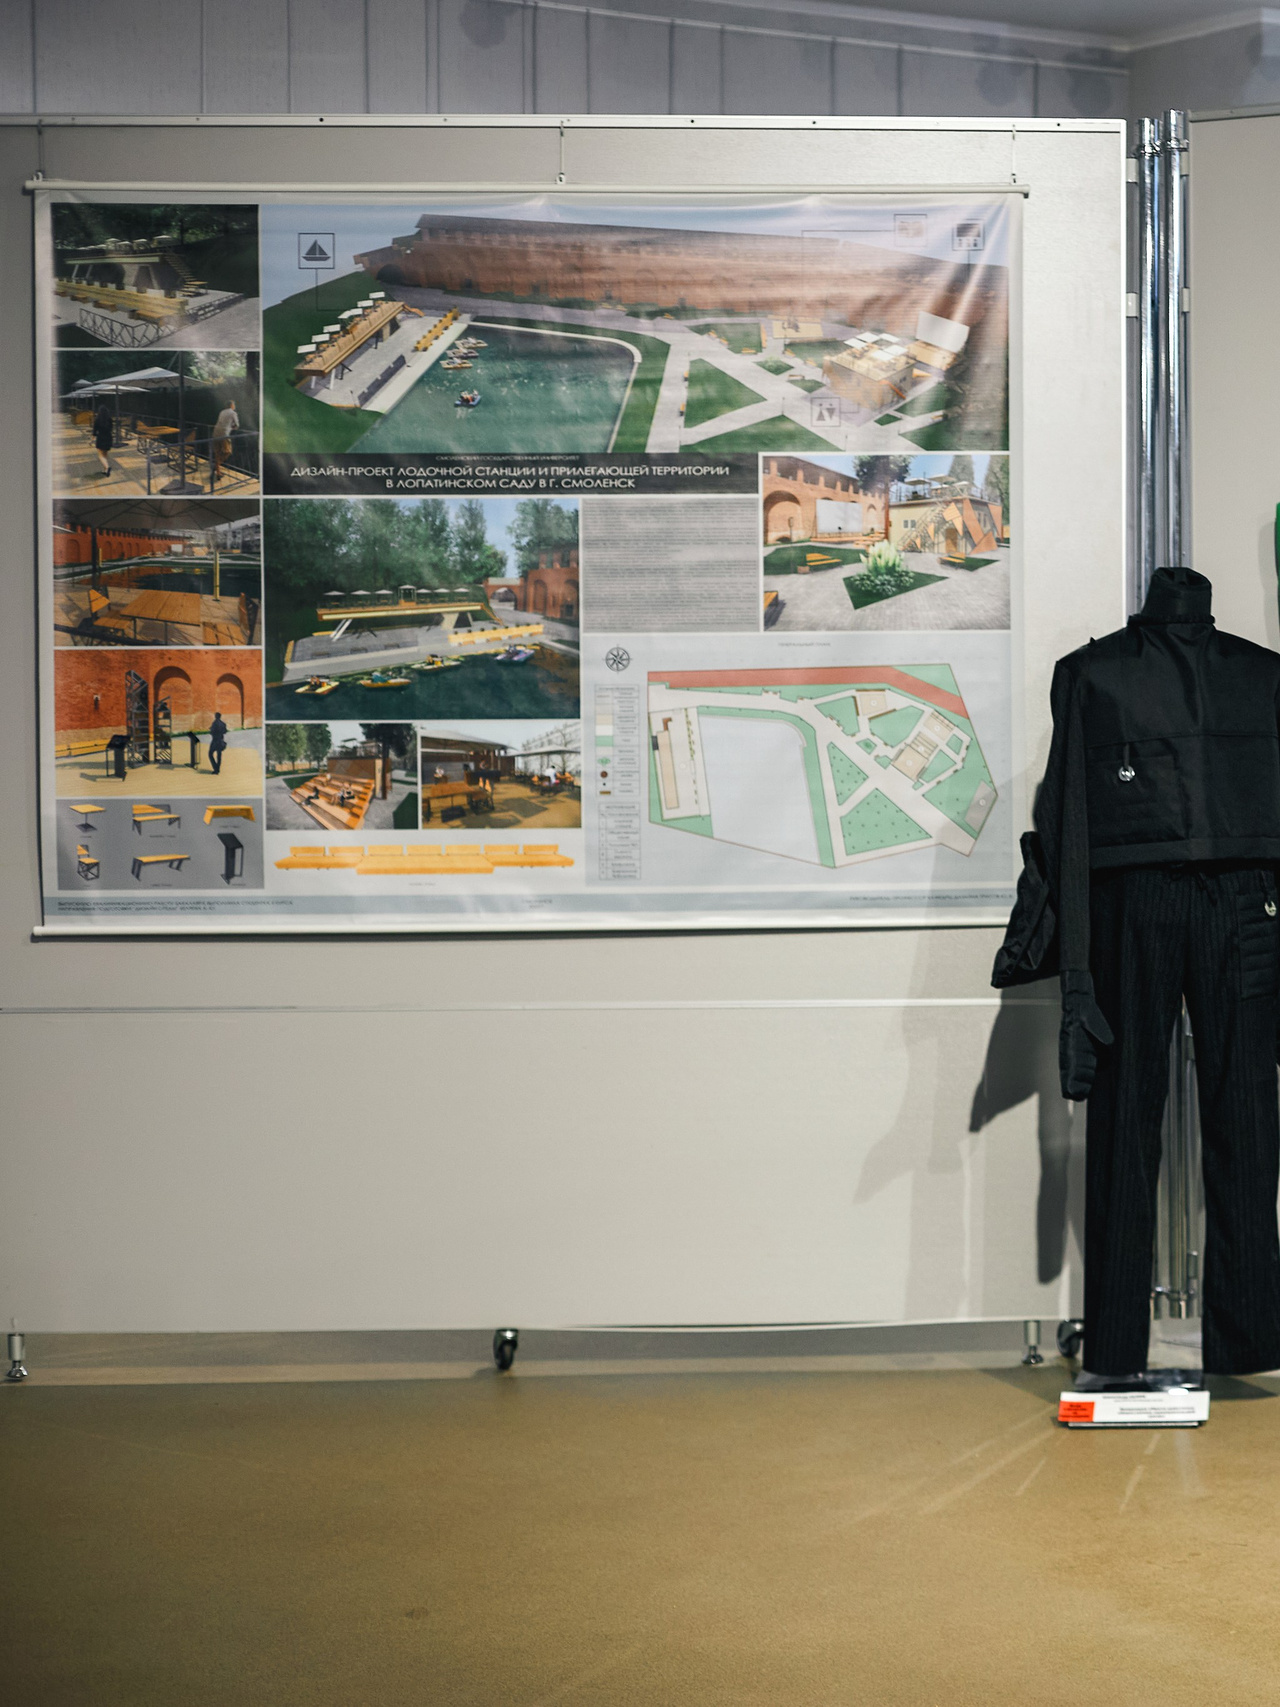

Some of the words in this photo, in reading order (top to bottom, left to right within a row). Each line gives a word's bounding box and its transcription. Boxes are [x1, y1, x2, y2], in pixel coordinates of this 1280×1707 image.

[290, 465, 394, 477] ДИЗАЙН-ПРОЕКТ
[397, 465, 472, 477] ЛОДОЧНОЙ
[474, 466, 536, 478] СТАНЦИИ
[538, 466, 548, 476] И
[551, 464, 649, 477] ПРИЛЕГАЮЩЕЙ
[651, 466, 730, 476] ТЕРРИТОРИИ
[386, 479, 393, 488] В
[396, 478, 497, 489] ЛОПАТИНСКОМ
[499, 478, 536, 489] САДУ
[539, 479, 546, 488] В
[549, 479, 558, 488] Г.
[561, 478, 635, 488] СМОЛЕНСК
